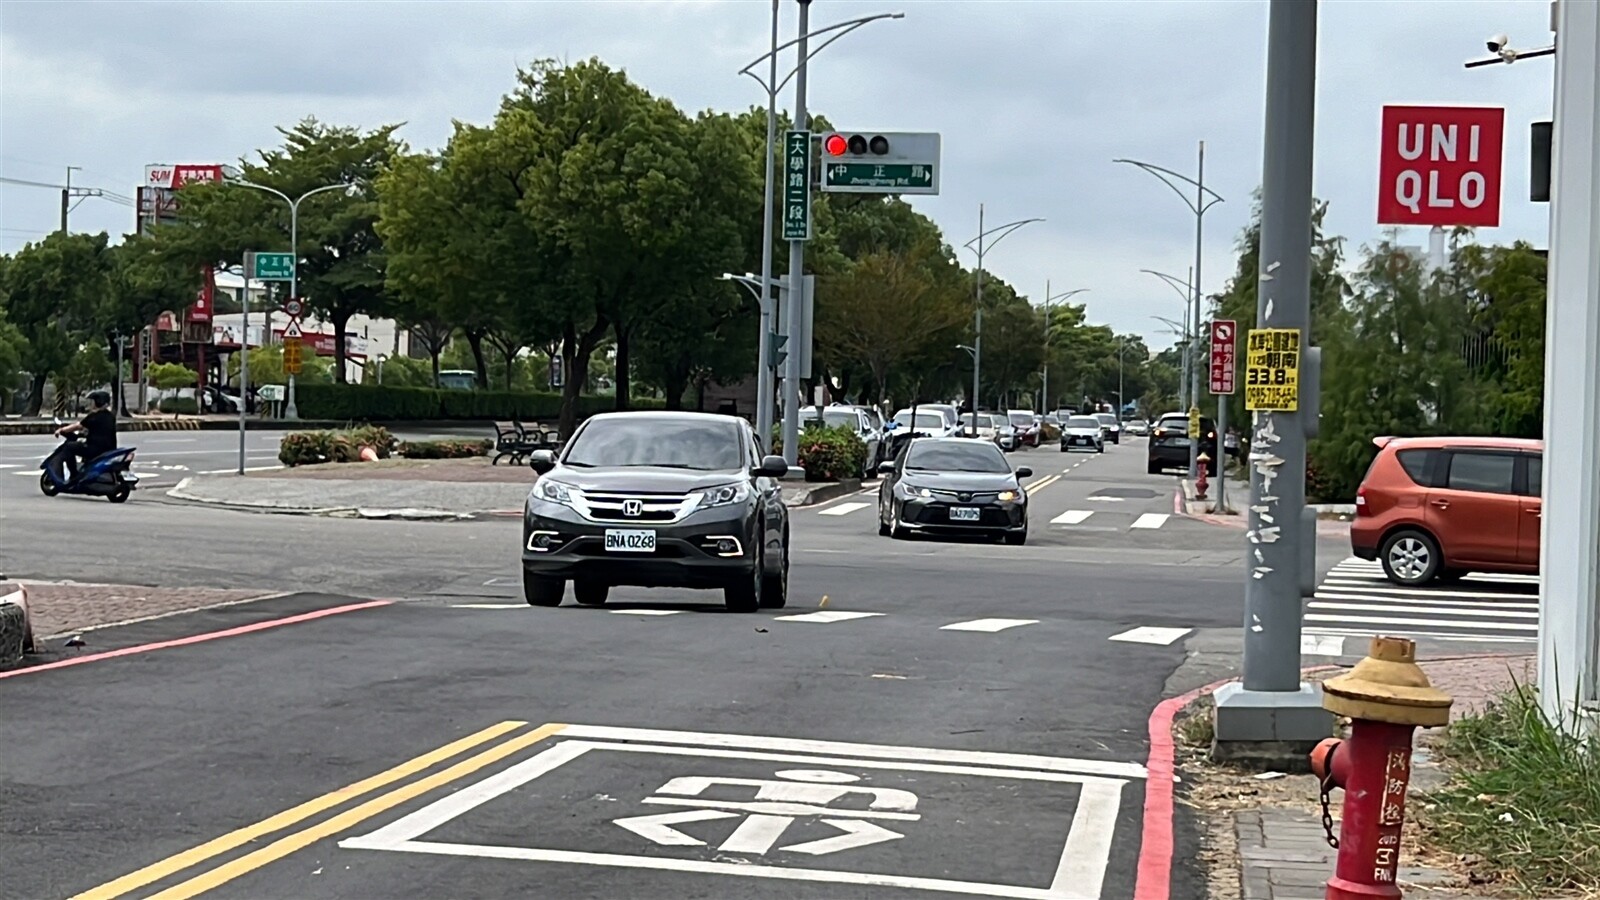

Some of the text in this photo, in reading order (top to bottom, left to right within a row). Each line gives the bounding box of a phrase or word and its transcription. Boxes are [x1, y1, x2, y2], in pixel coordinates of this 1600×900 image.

[1397, 123, 1480, 162] UNI
[150, 170, 172, 183] SUM
[789, 140, 805, 220] 大學路二段
[834, 164, 925, 178] 中正路
[1395, 169, 1486, 214] QLO
[1247, 368, 1287, 385] 33.8
